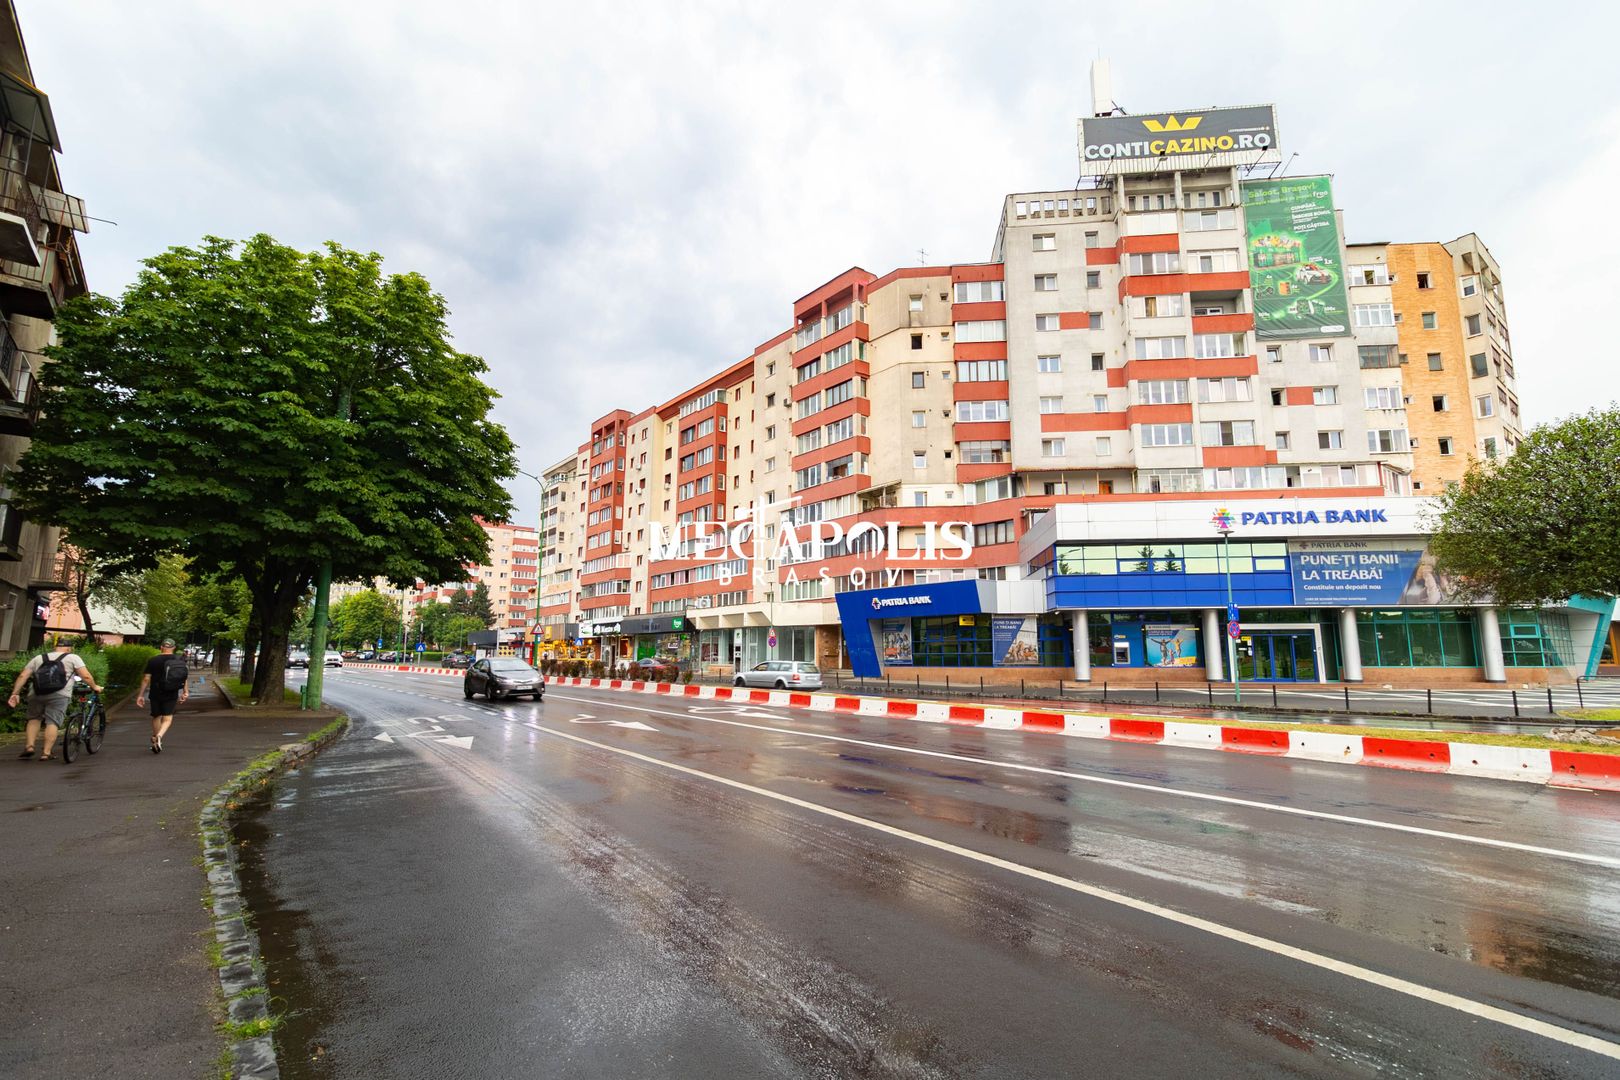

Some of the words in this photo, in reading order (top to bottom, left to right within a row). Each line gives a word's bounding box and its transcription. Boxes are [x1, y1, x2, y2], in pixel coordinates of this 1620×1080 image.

[1085, 133, 1271, 160] CONTICAZINO.RO
[1241, 509, 1320, 526] PATRIA
[1326, 508, 1389, 524] BANK
[1311, 541, 1342, 549] PATRIA
[1343, 541, 1368, 549] BANK
[1300, 554, 1355, 567] PUNE-ȚI
[1359, 553, 1399, 565] BANII
[1302, 570, 1320, 580] LA
[1322, 567, 1383, 580] TREABĂ!
[881, 597, 908, 607] PATRIA
[908, 595, 932, 605] BANK
